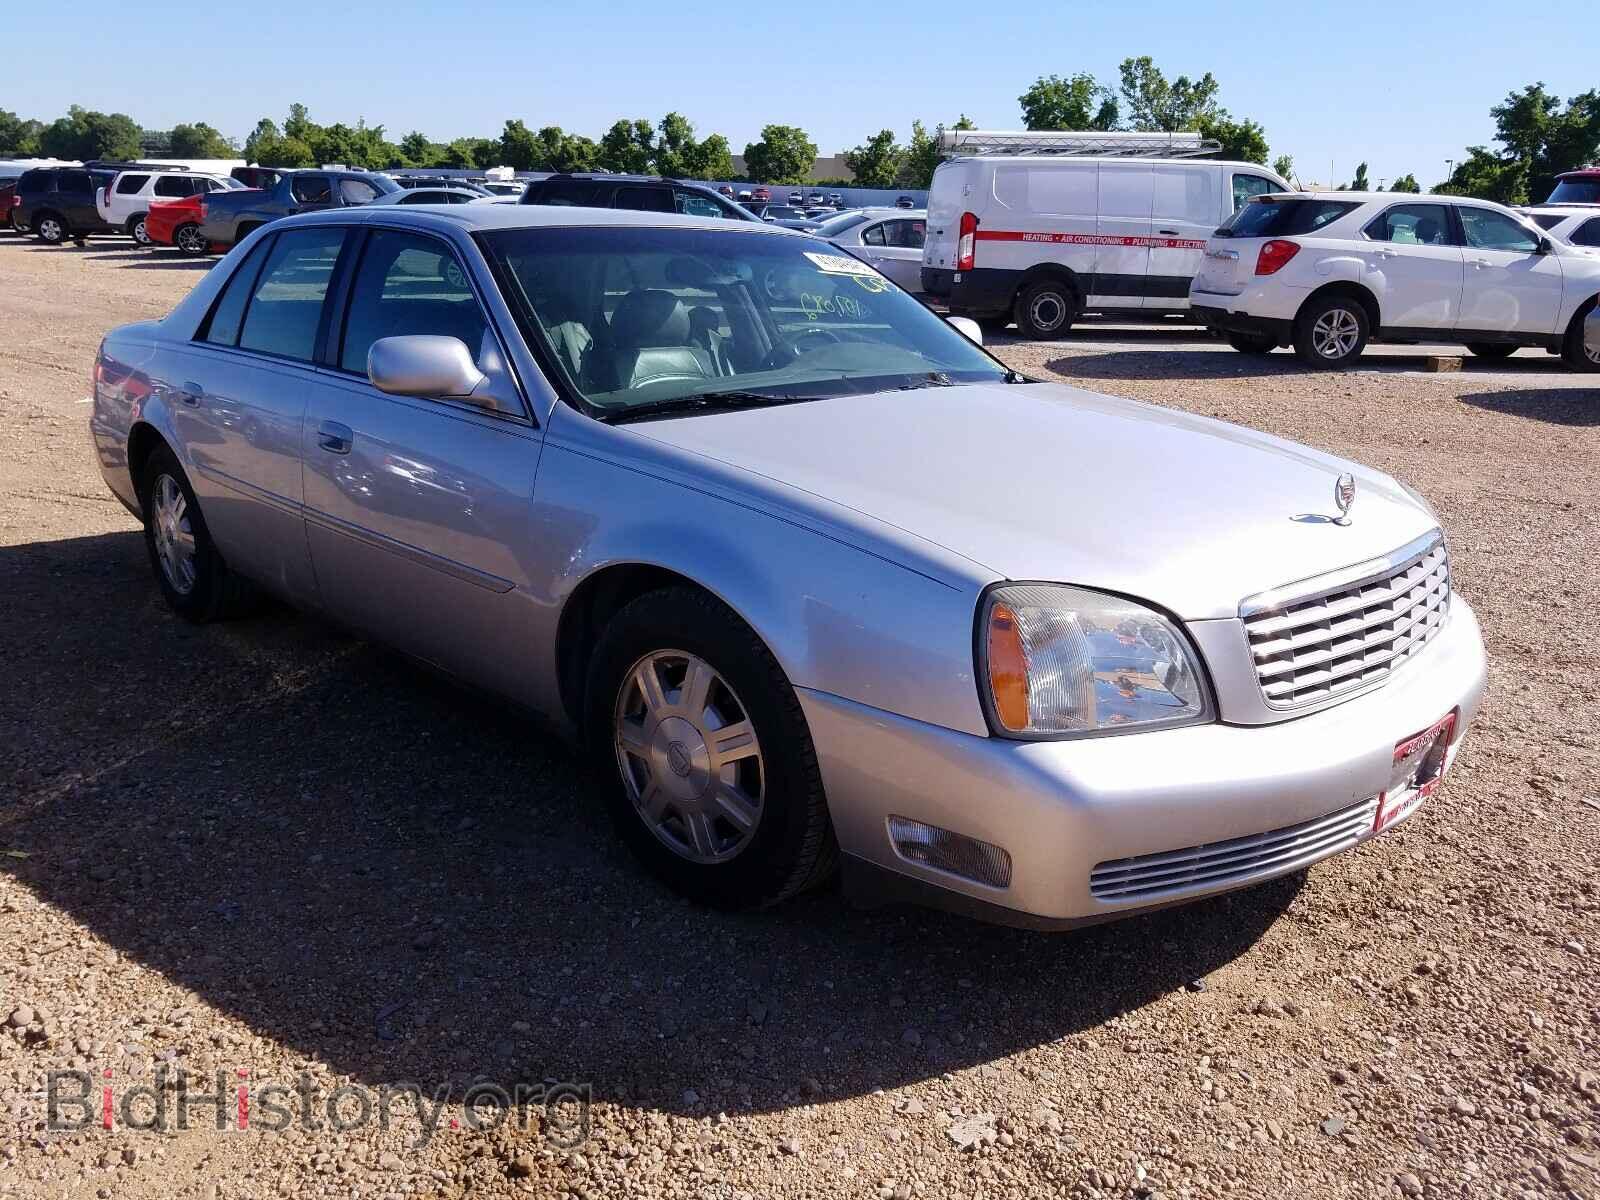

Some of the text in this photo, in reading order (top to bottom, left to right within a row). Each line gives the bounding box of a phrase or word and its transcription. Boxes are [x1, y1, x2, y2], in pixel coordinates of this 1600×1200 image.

[1022, 233, 1053, 242] HEATING
[1061, 235, 1074, 243] AIR
[1074, 235, 1125, 245] CONDITIONING
[1132, 238, 1169, 247] PLUMBING
